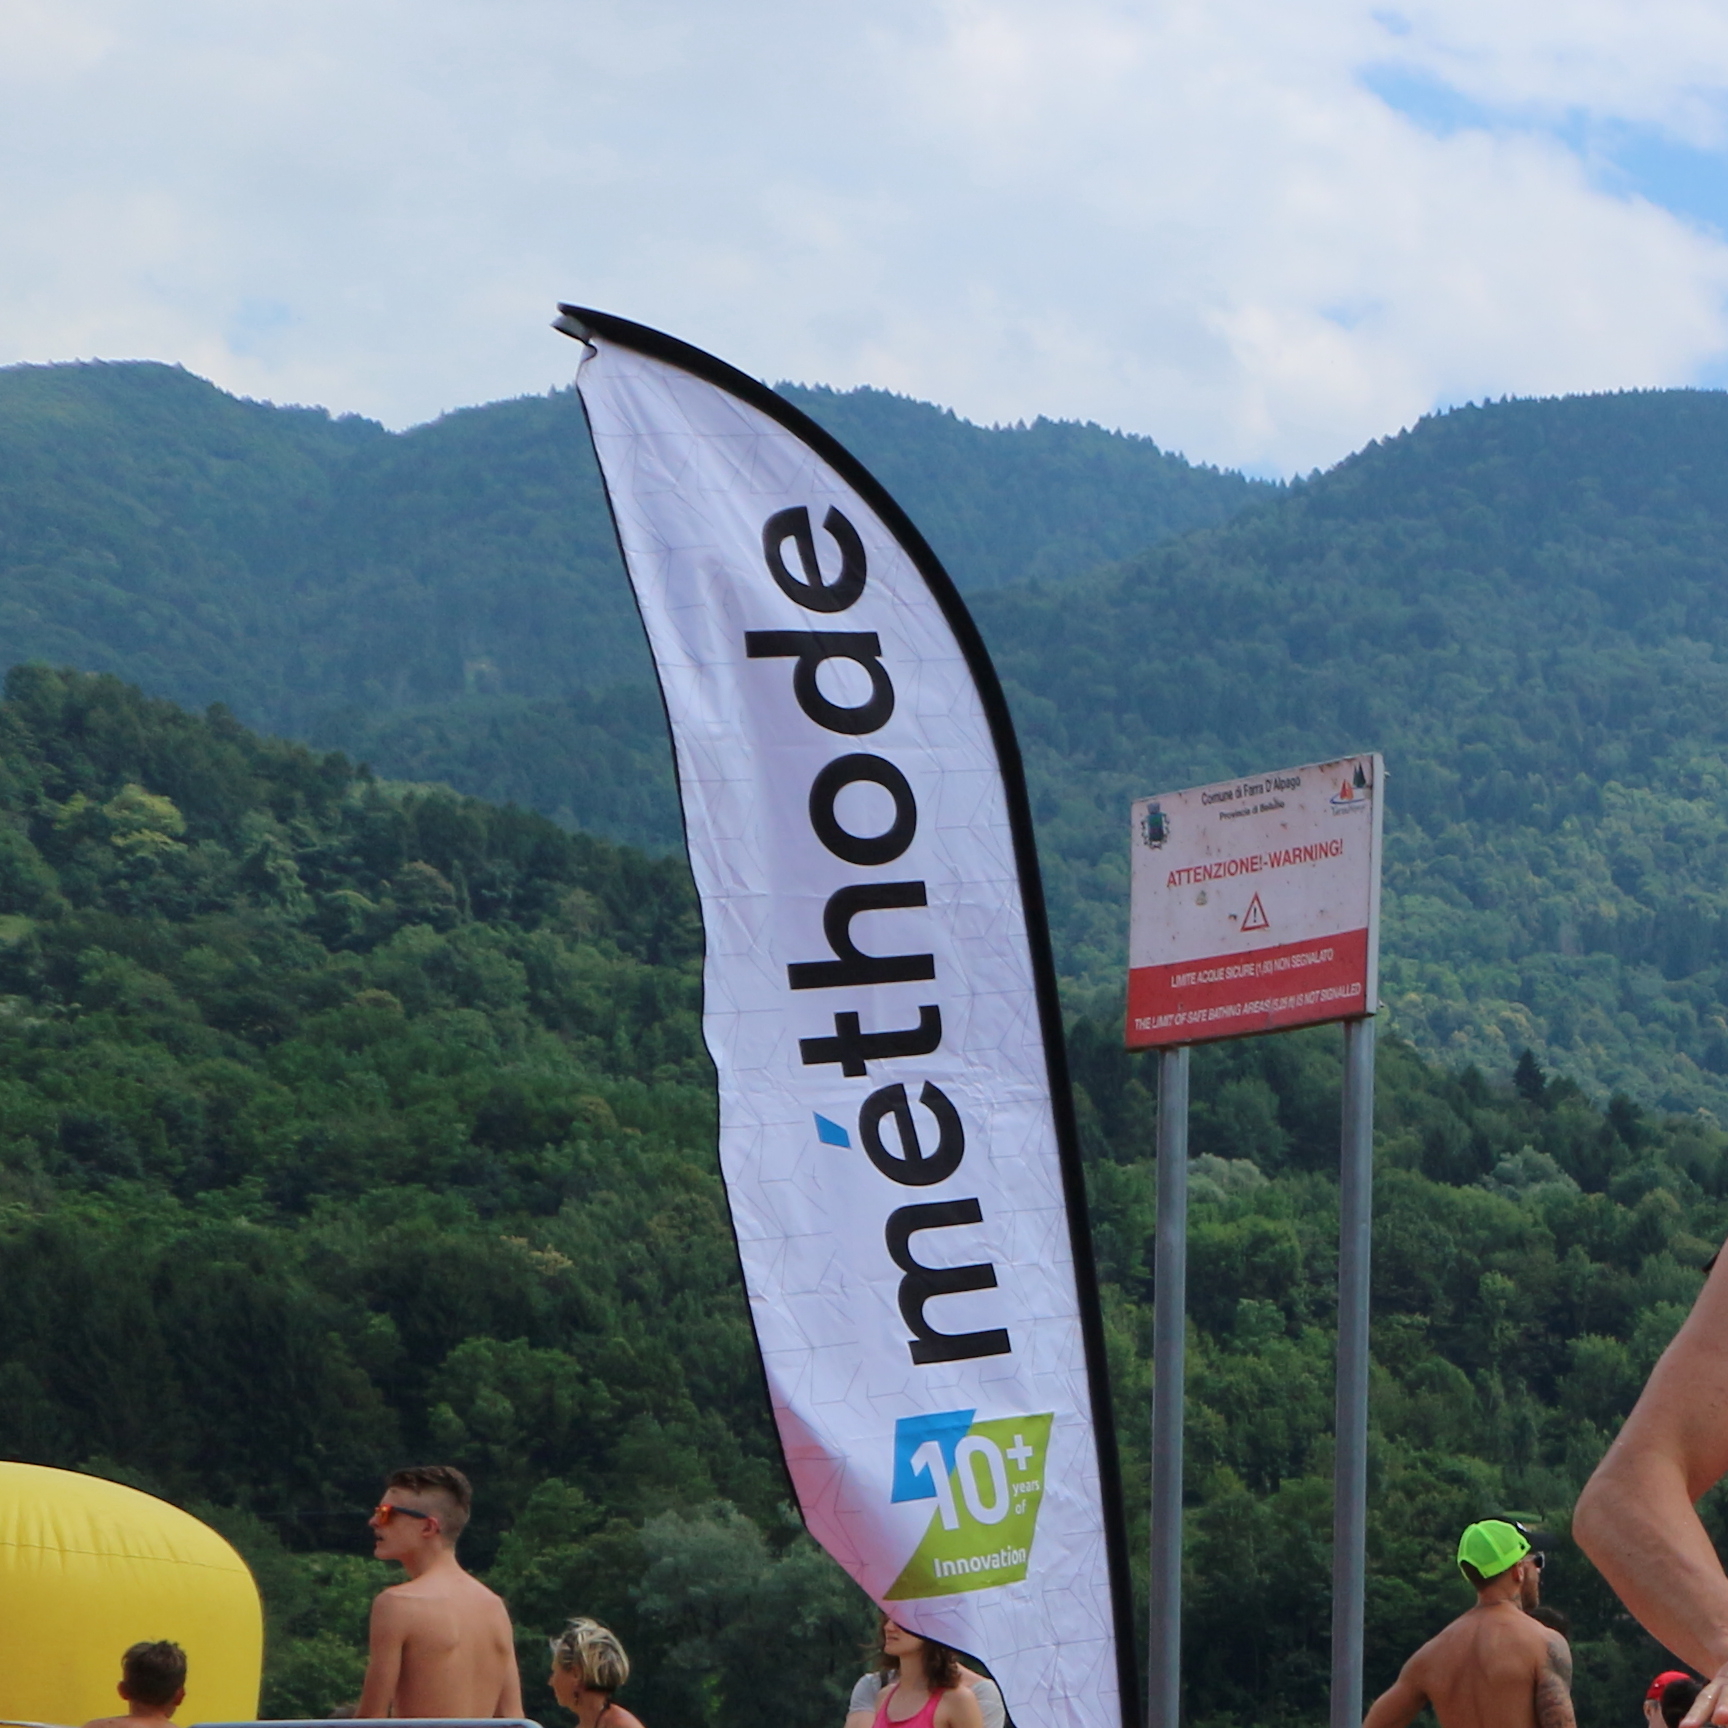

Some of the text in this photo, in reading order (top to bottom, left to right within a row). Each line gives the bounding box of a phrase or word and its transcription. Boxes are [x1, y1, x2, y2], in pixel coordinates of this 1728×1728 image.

[1201, 776, 1301, 806] Comune di Farra D'Alpago
[746, 504, 1011, 1366] méthode
[1171, 971, 1197, 989] LIMITE
[1197, 966, 1225, 984] ACQUE
[1225, 963, 1255, 980] SICURE
[1273, 956, 1291, 972] NON
[1291, 947, 1334, 969] SEGNALATO
[1134, 1016, 1151, 1031] THE
[1151, 1013, 1175, 1030] LIMIT
[1174, 1011, 1187, 1026] OF
[1186, 1008, 1207, 1025] SAFE
[1207, 1003, 1241, 1022] BATHING
[1241, 999, 1271, 1015] AREAS
[1303, 990, 1320, 1005] NOT
[1320, 981, 1361, 1002] SIGNALLED
[1012, 1478, 1040, 1497] years
[1015, 1499, 1027, 1515] of
[933, 1544, 1026, 1579] Innovation
